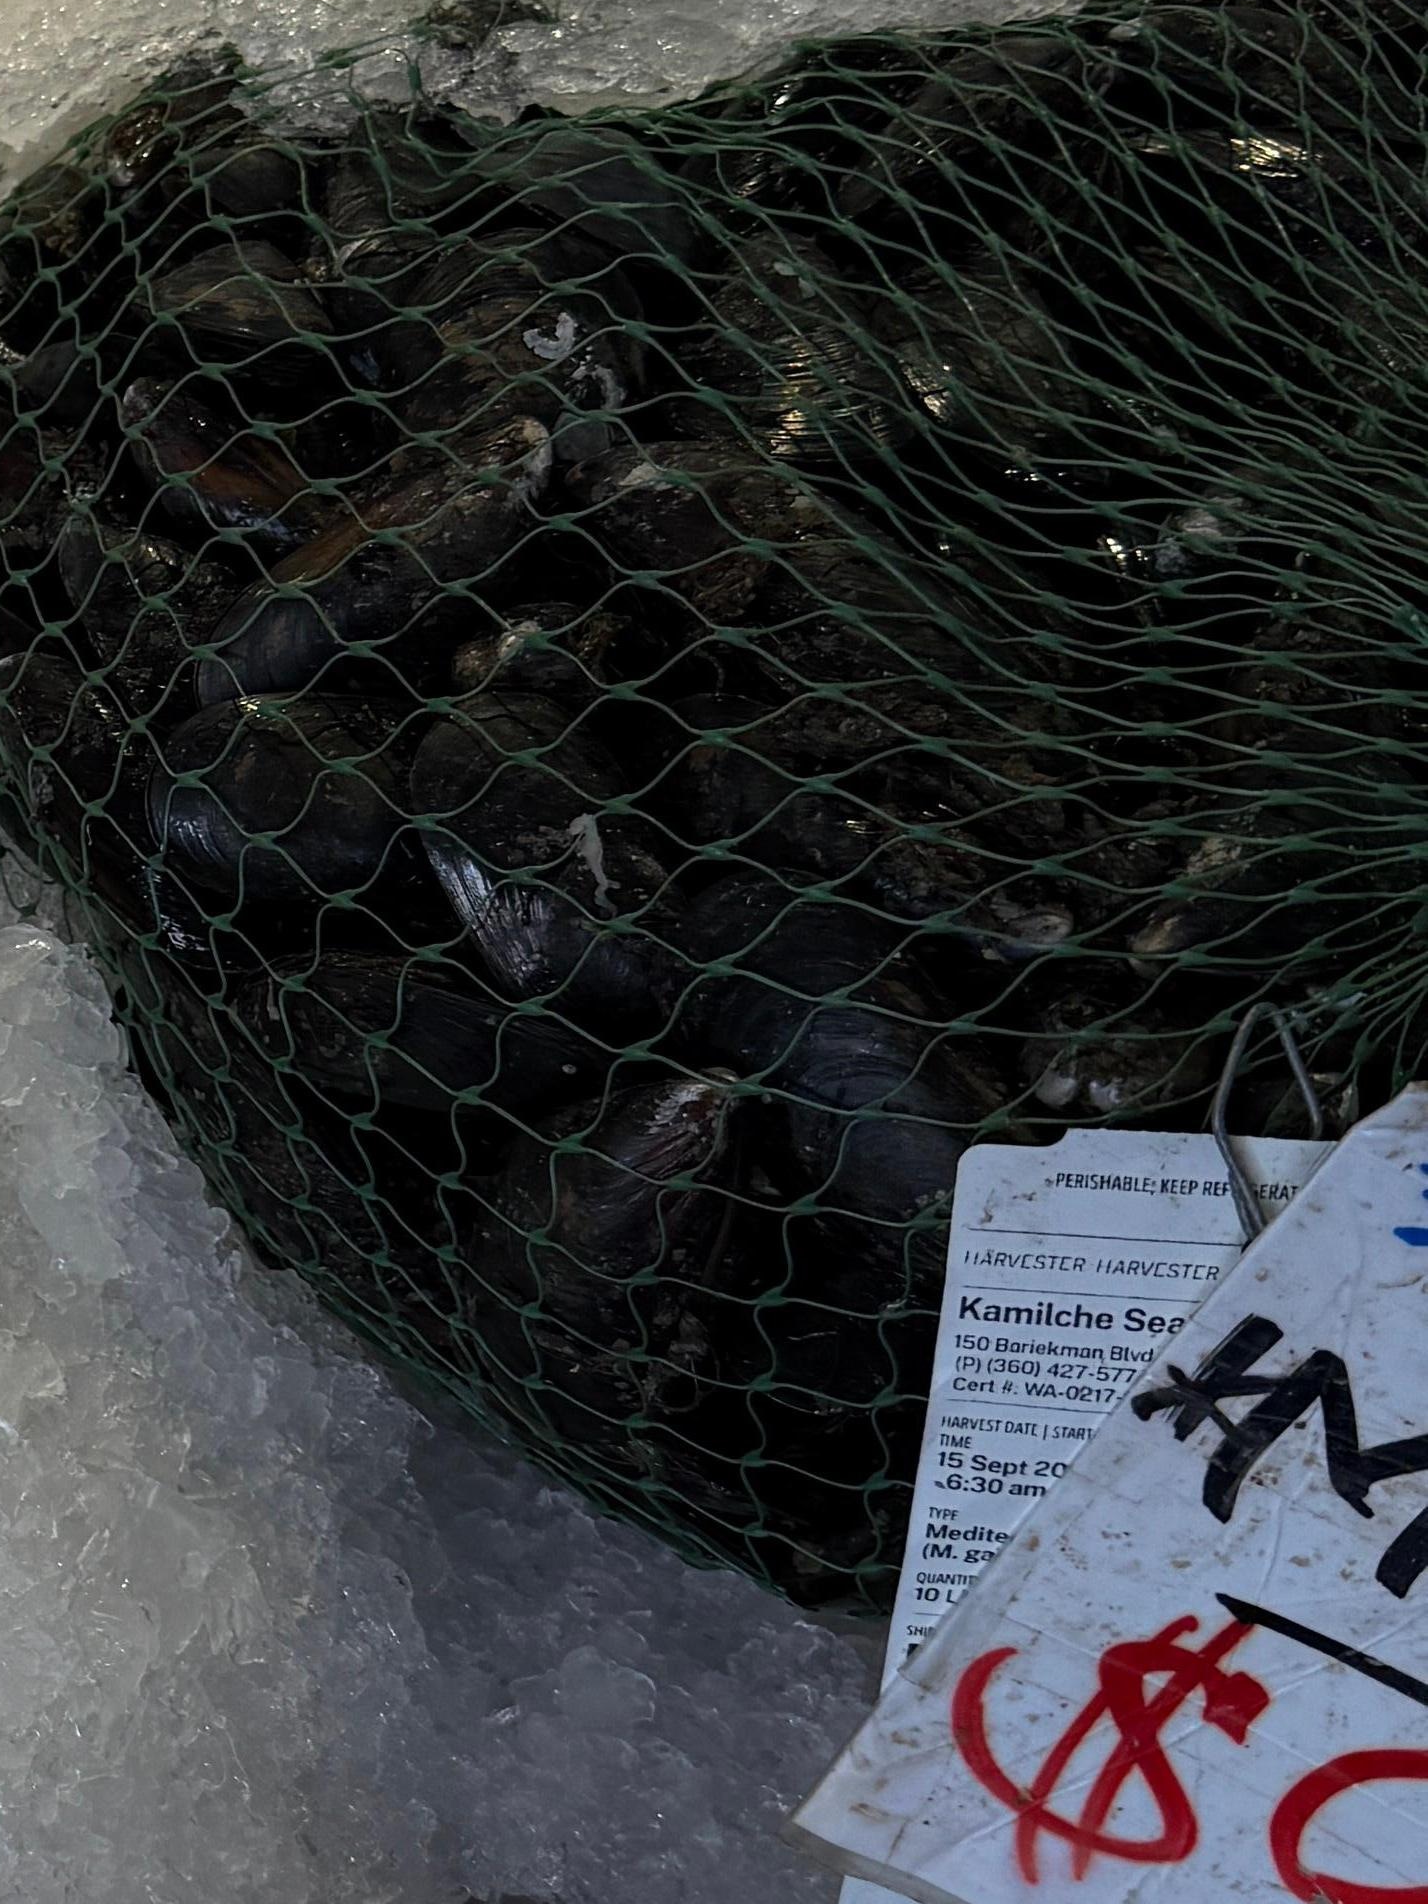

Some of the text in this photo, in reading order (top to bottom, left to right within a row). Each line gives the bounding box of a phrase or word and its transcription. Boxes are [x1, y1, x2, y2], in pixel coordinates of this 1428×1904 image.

[1160, 1178, 1199, 1197] KEEP
[964, 1250, 1220, 1282] HARVESTER HARVESTER
[958, 1296, 1185, 1335] Kamilche Sea
[954, 1334, 990, 1352] 150
[955, 1354, 982, 1375] (P)
[986, 1358, 1041, 1379] (360)
[952, 1377, 995, 1394] Cert
[941, 1416, 1002, 1433] HARVEST
[1004, 1420, 1038, 1437] DATE
[940, 1434, 972, 1449] TIME
[937, 1451, 964, 1469] 15
[970, 1455, 1028, 1477] Sept
[945, 1473, 1048, 1497] 6:30 am
[928, 1506, 959, 1521] TYPE
[922, 1542, 958, 1561] (M.
[915, 1586, 940, 1602] 10
